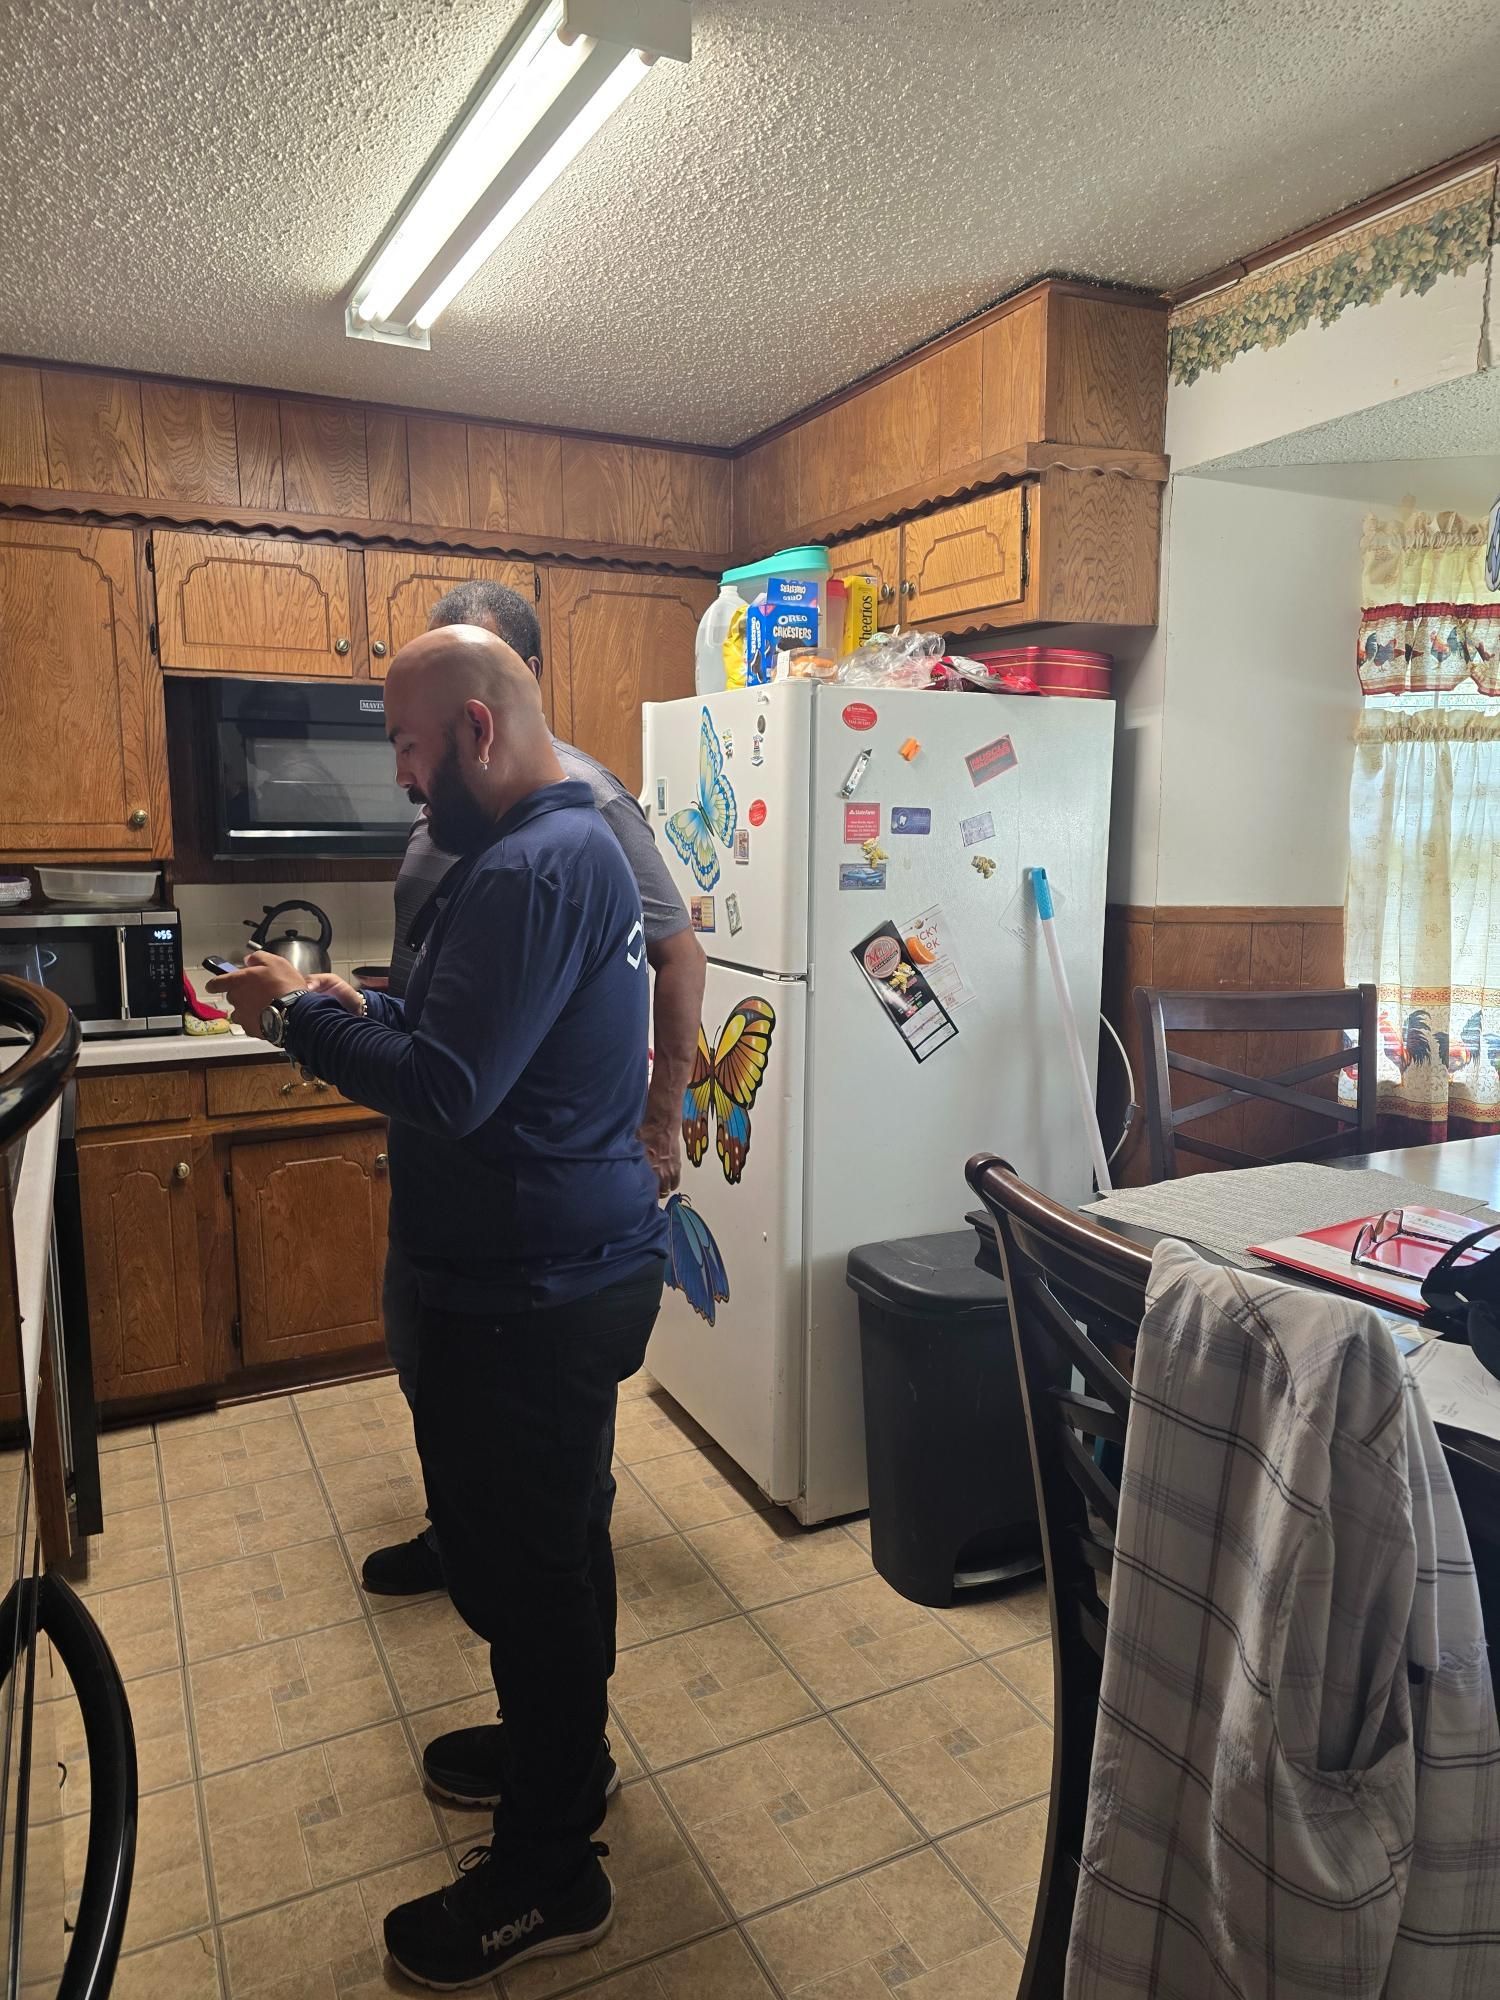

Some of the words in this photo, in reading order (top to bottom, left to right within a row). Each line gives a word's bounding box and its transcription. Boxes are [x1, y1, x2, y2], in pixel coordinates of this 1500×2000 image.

[778, 614, 808, 624] OREO
[773, 626, 812, 640] CAKESTERS
[481, 1908, 545, 1957] HOKA
